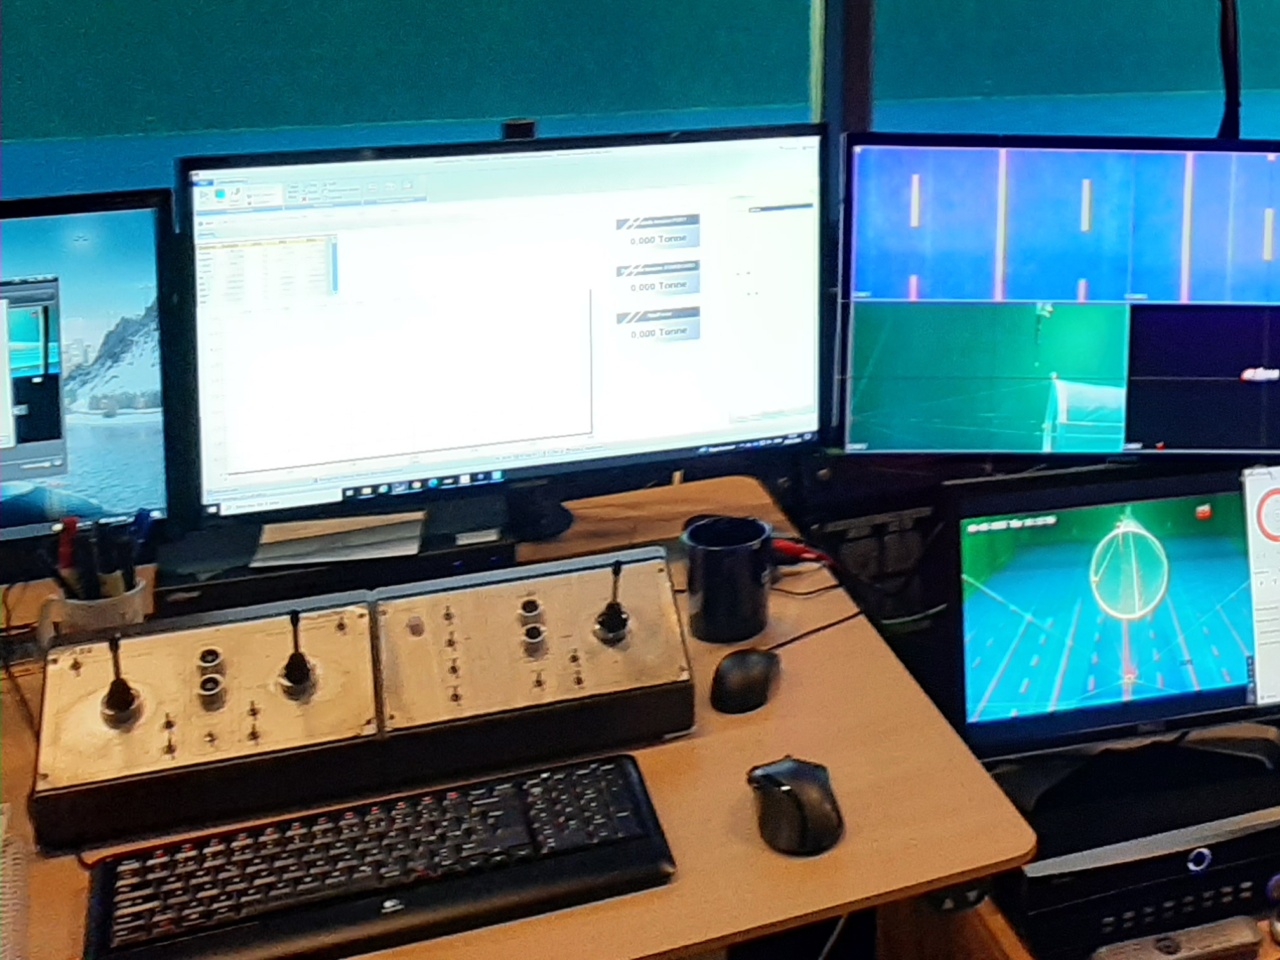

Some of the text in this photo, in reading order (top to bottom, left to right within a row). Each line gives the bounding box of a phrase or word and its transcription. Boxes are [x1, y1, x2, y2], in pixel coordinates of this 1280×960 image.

[659, 234, 688, 244] Tonne
[659, 280, 688, 290] Tonne
[659, 327, 688, 337] Tonne
